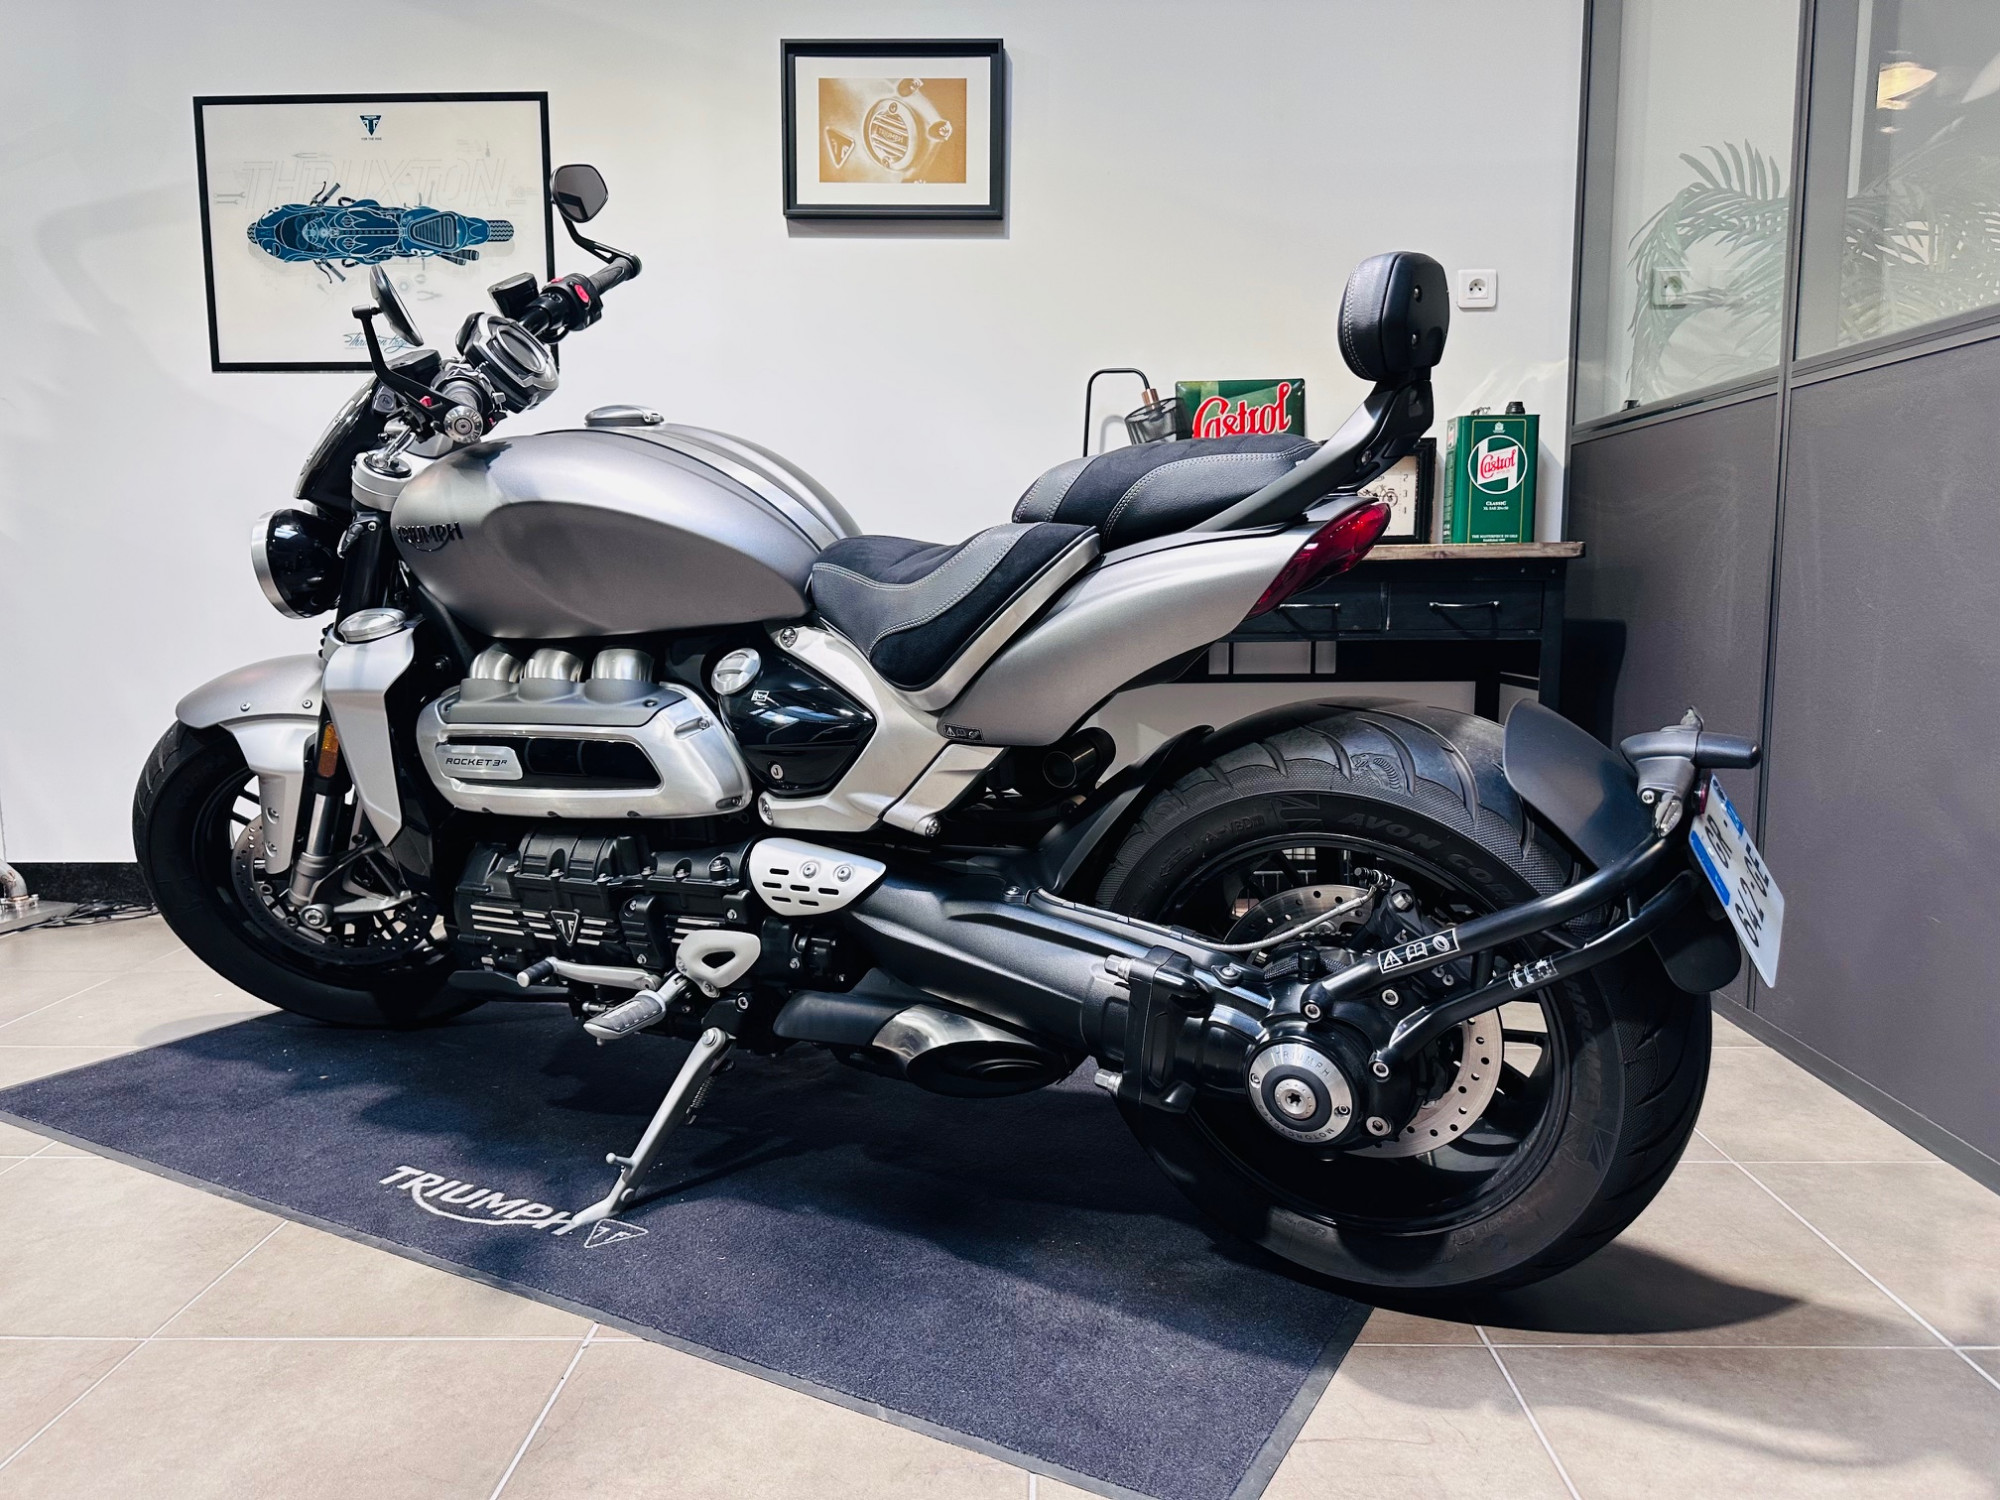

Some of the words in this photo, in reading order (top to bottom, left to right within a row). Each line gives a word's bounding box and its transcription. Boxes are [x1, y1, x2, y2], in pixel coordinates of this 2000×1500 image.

[1192, 382, 1292, 438] Castrol
[1480, 448, 1517, 479] Castrol
[396, 521, 464, 552] TRIUMPH
[1338, 812, 1442, 850] AVON
[379, 1165, 578, 1236] TRIUMPH
